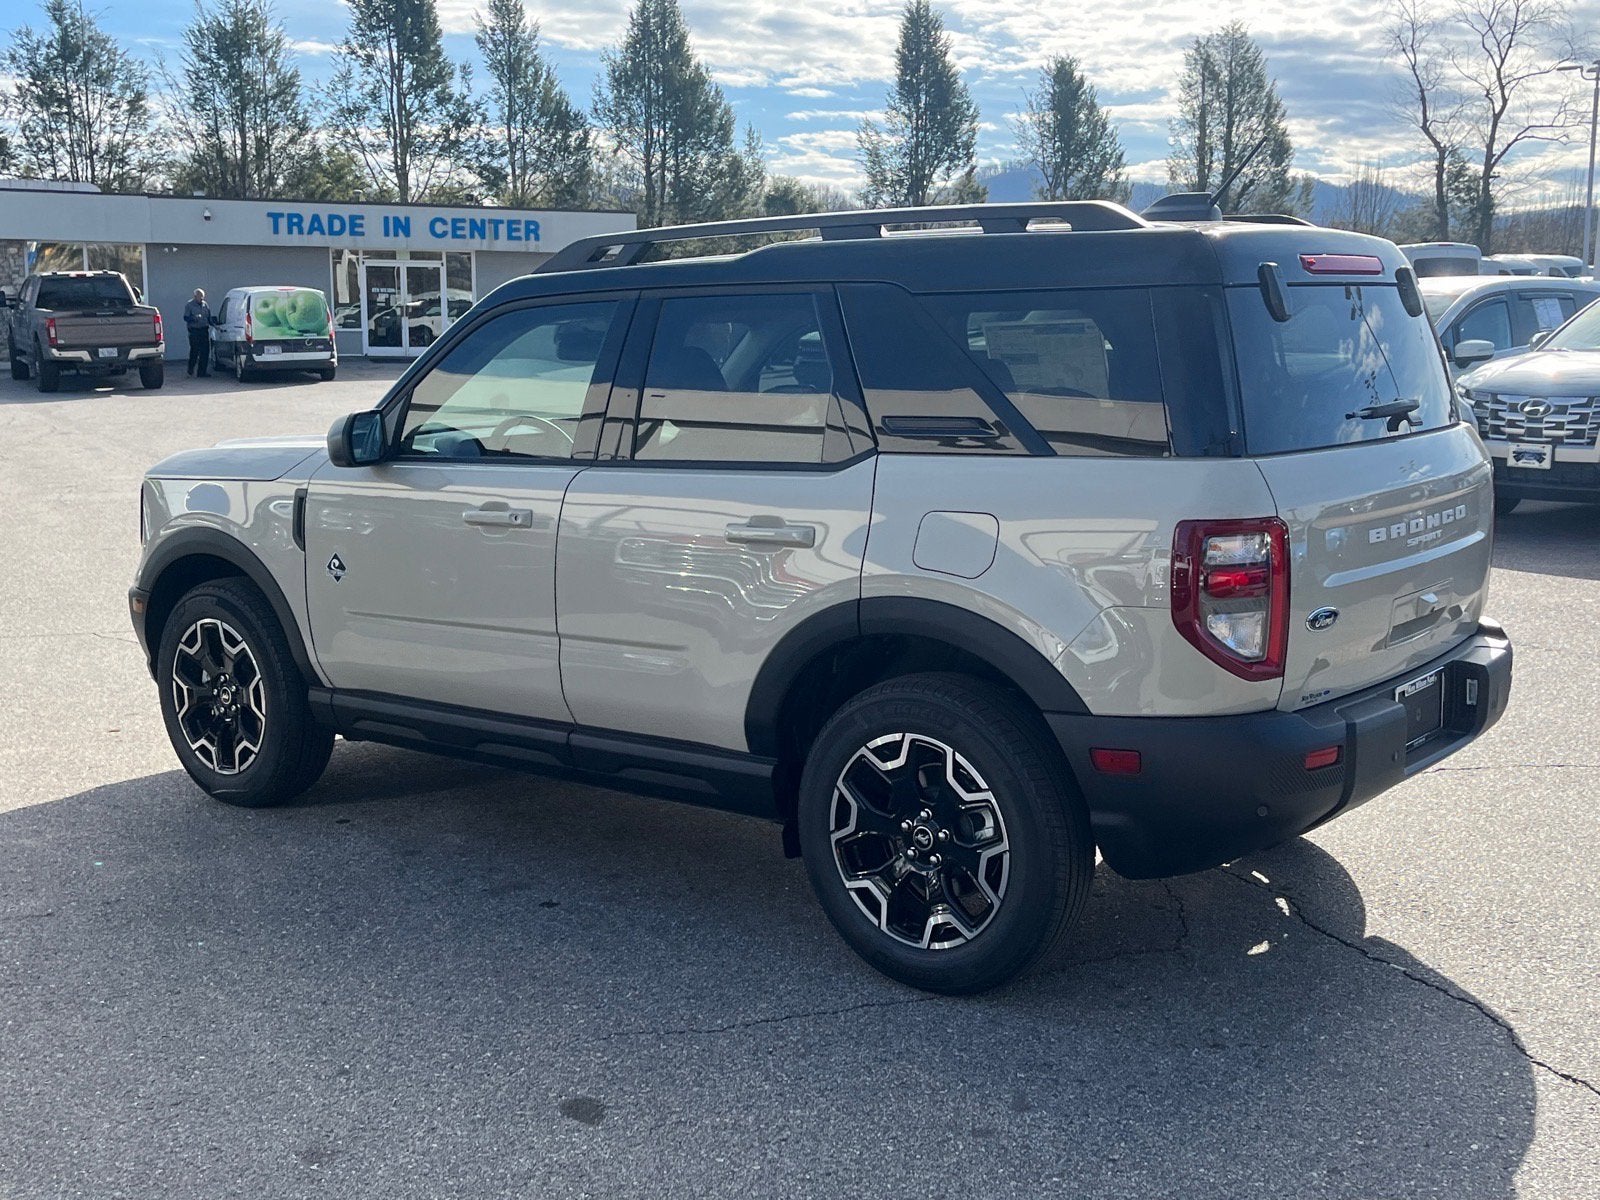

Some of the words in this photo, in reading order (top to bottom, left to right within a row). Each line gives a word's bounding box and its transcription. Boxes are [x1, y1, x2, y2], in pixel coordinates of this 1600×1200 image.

[267, 212, 365, 236] TRADE
[383, 216, 410, 237] IN
[429, 217, 540, 241] CENTER
[1369, 504, 1466, 544] BRONCO
[1406, 529, 1442, 547] SPORT
[1313, 610, 1336, 629] Ford
